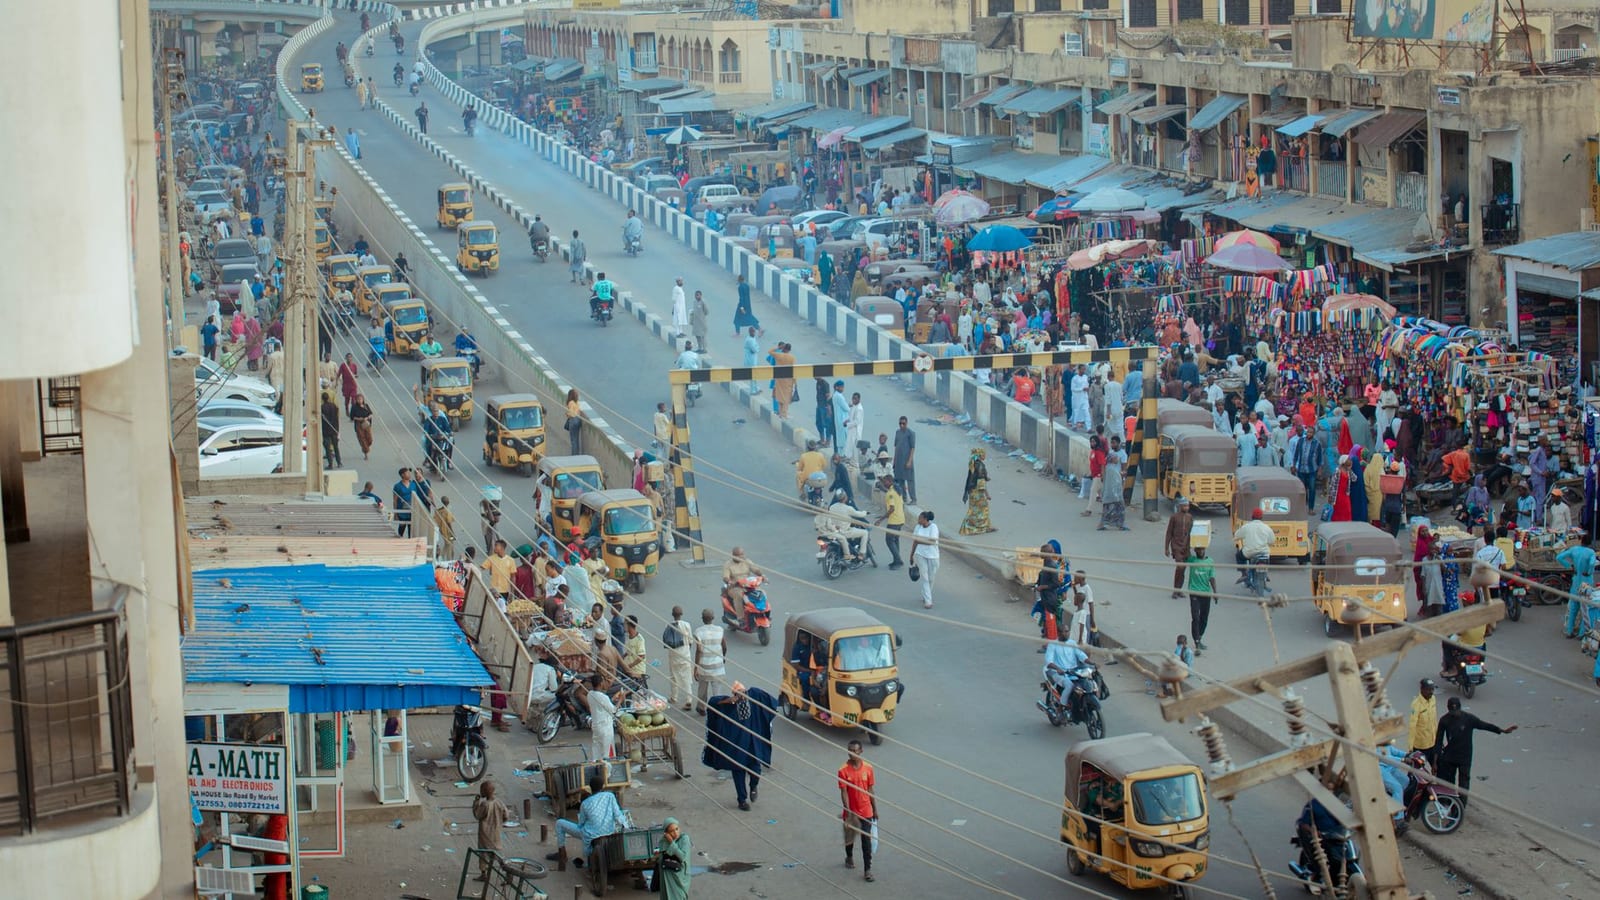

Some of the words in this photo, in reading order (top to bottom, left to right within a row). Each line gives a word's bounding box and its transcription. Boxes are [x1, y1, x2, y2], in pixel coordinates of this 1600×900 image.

[201, 779, 217, 788] AND
[222, 780, 274, 791] ELECTRONICS
[249, 793, 257, 801] By
